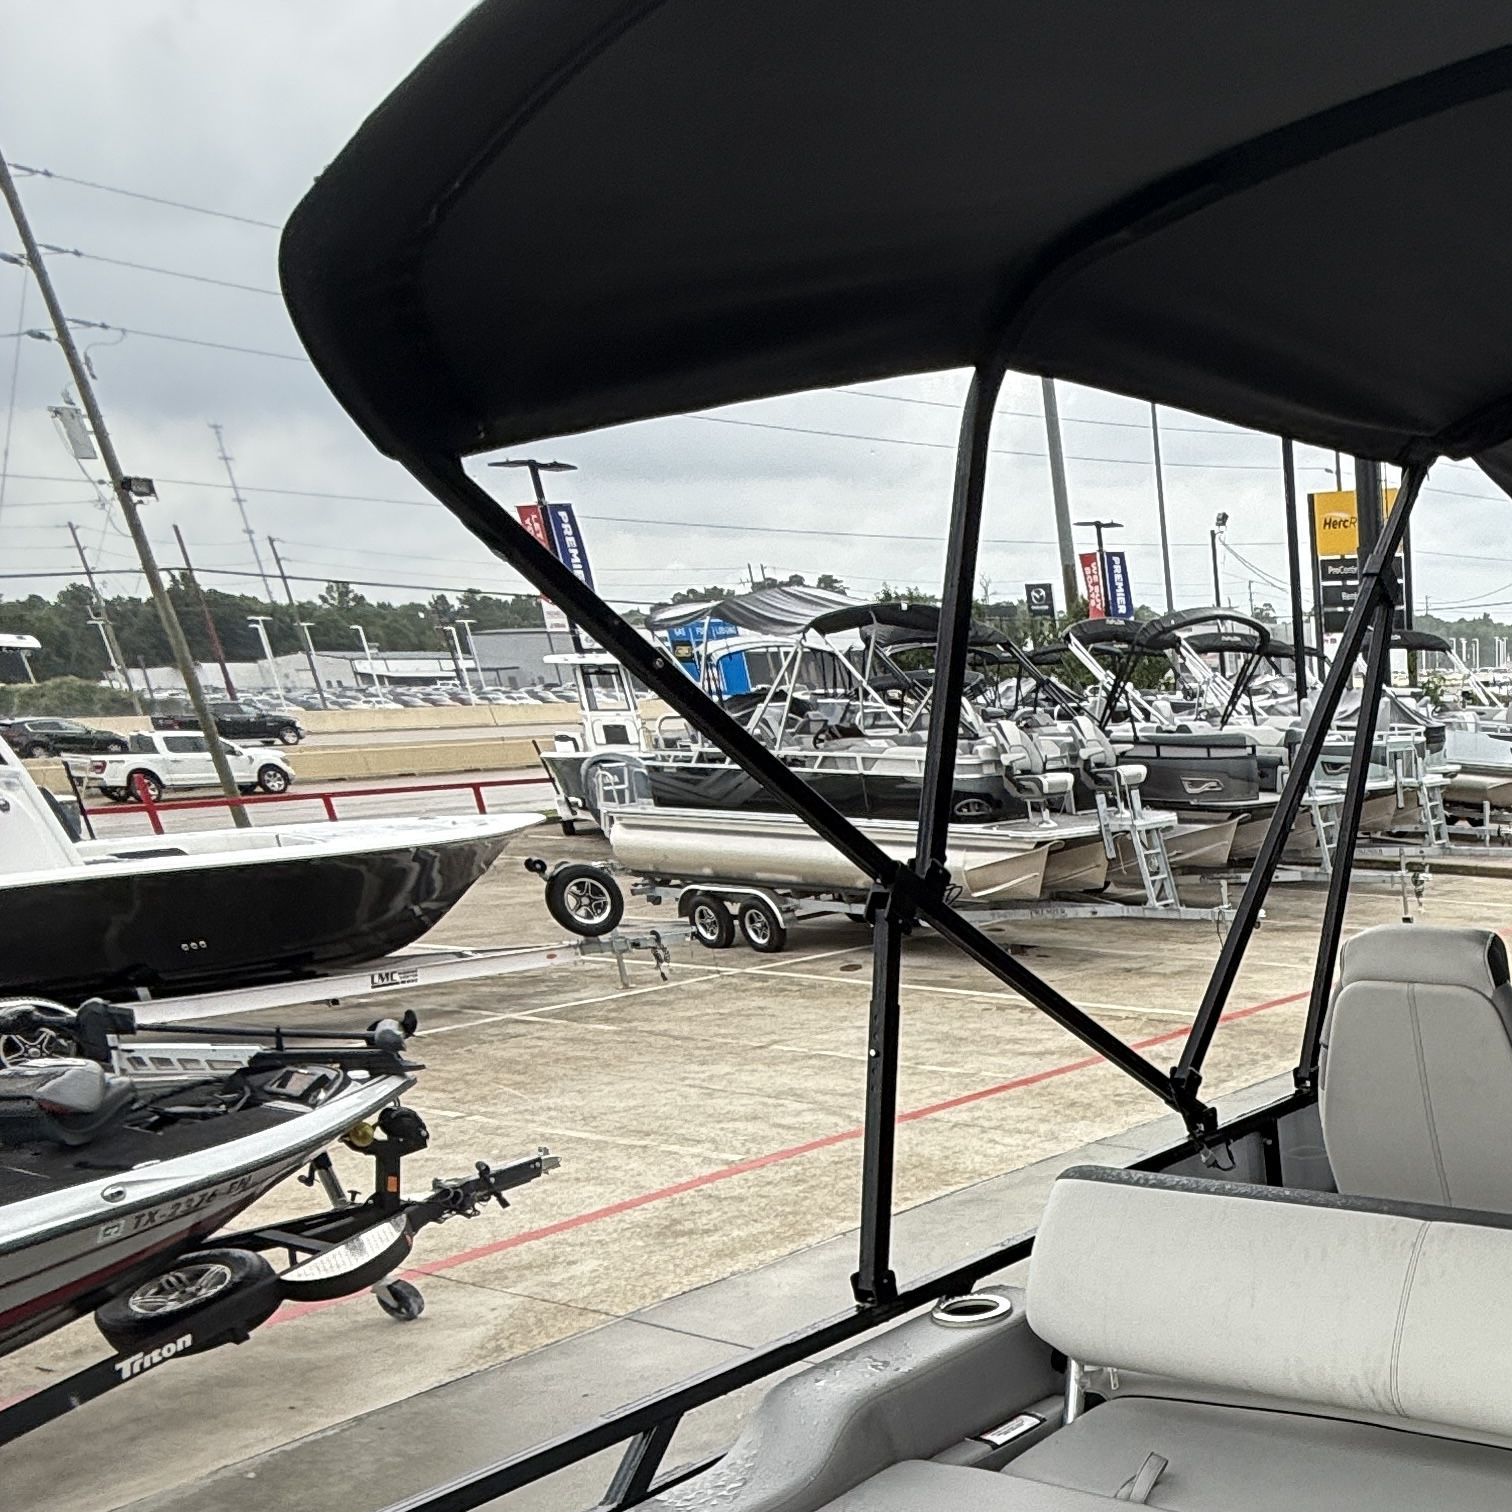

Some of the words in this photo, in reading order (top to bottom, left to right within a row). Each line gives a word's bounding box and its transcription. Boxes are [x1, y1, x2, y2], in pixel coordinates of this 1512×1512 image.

[1112, 556, 1127, 614] PREMIER
[370, 970, 398, 986] LMC
[114, 1333, 193, 1381] Triton
